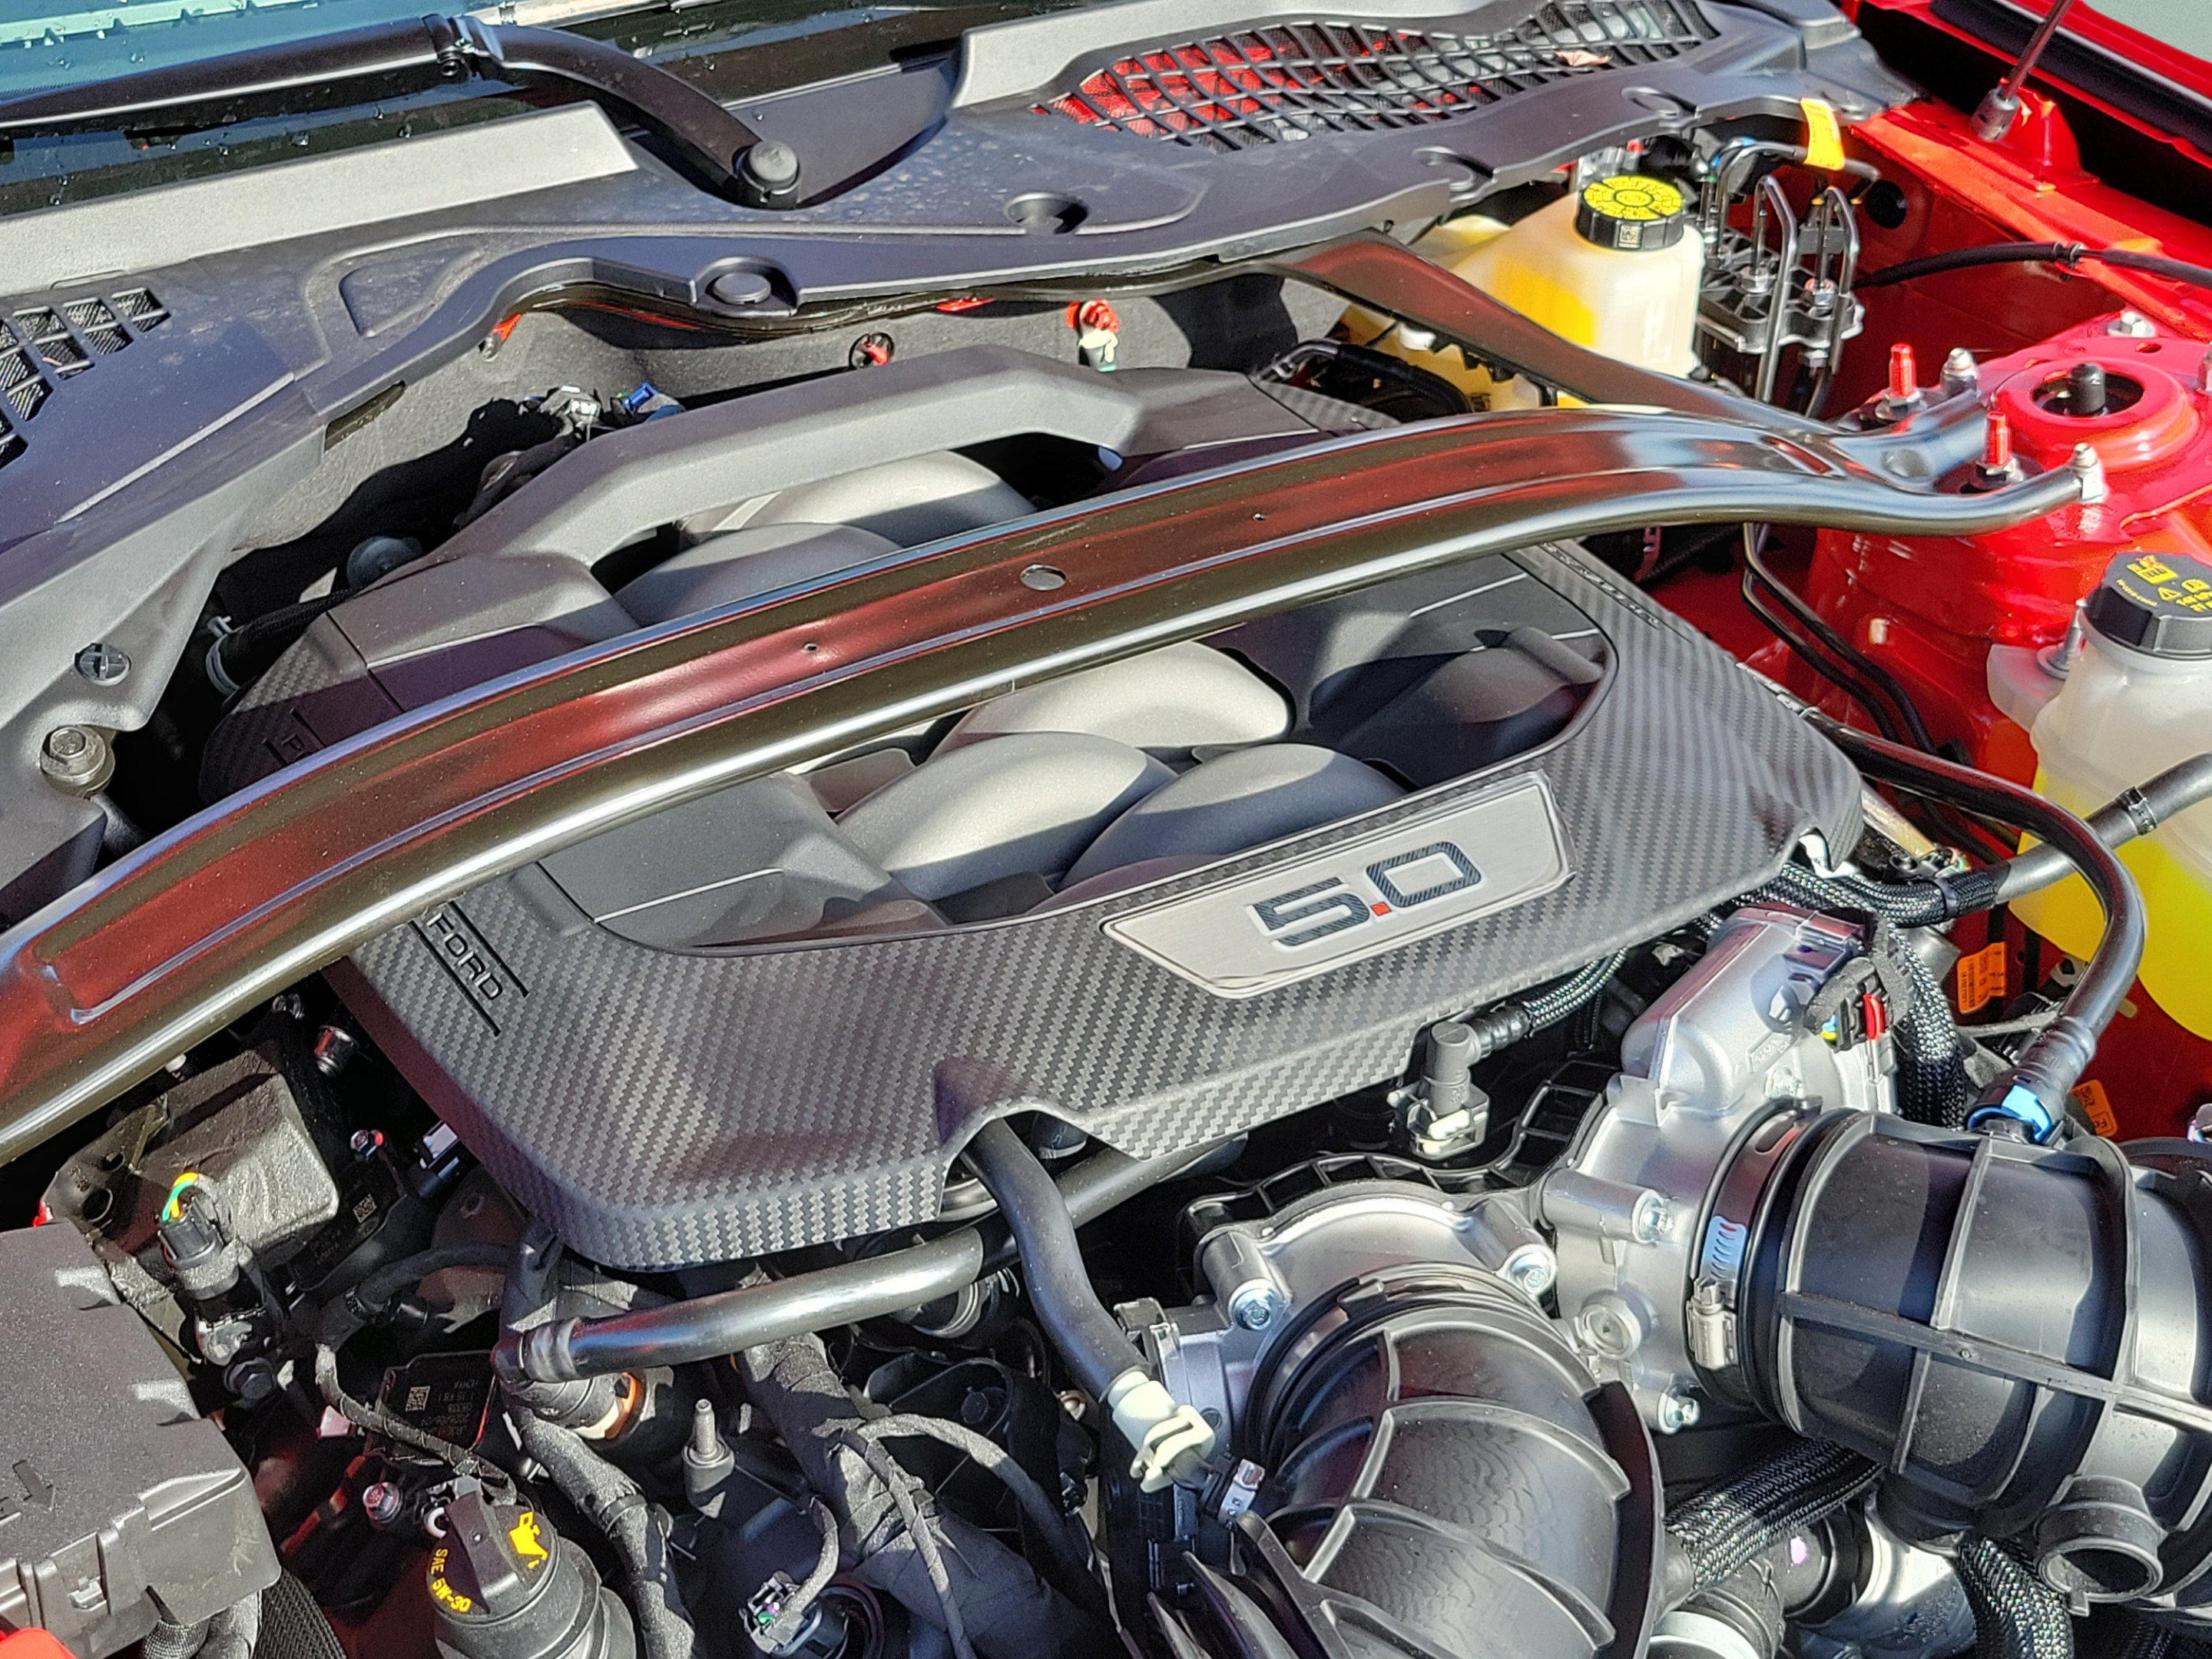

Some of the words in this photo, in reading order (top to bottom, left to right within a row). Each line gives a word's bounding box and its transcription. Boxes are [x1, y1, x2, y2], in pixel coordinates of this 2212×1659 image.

[1249, 840, 1484, 949] 5.0
[426, 912, 503, 1000] FORD
[431, 1548, 449, 1575] SAE
[432, 1577, 472, 1612] 5W-30
